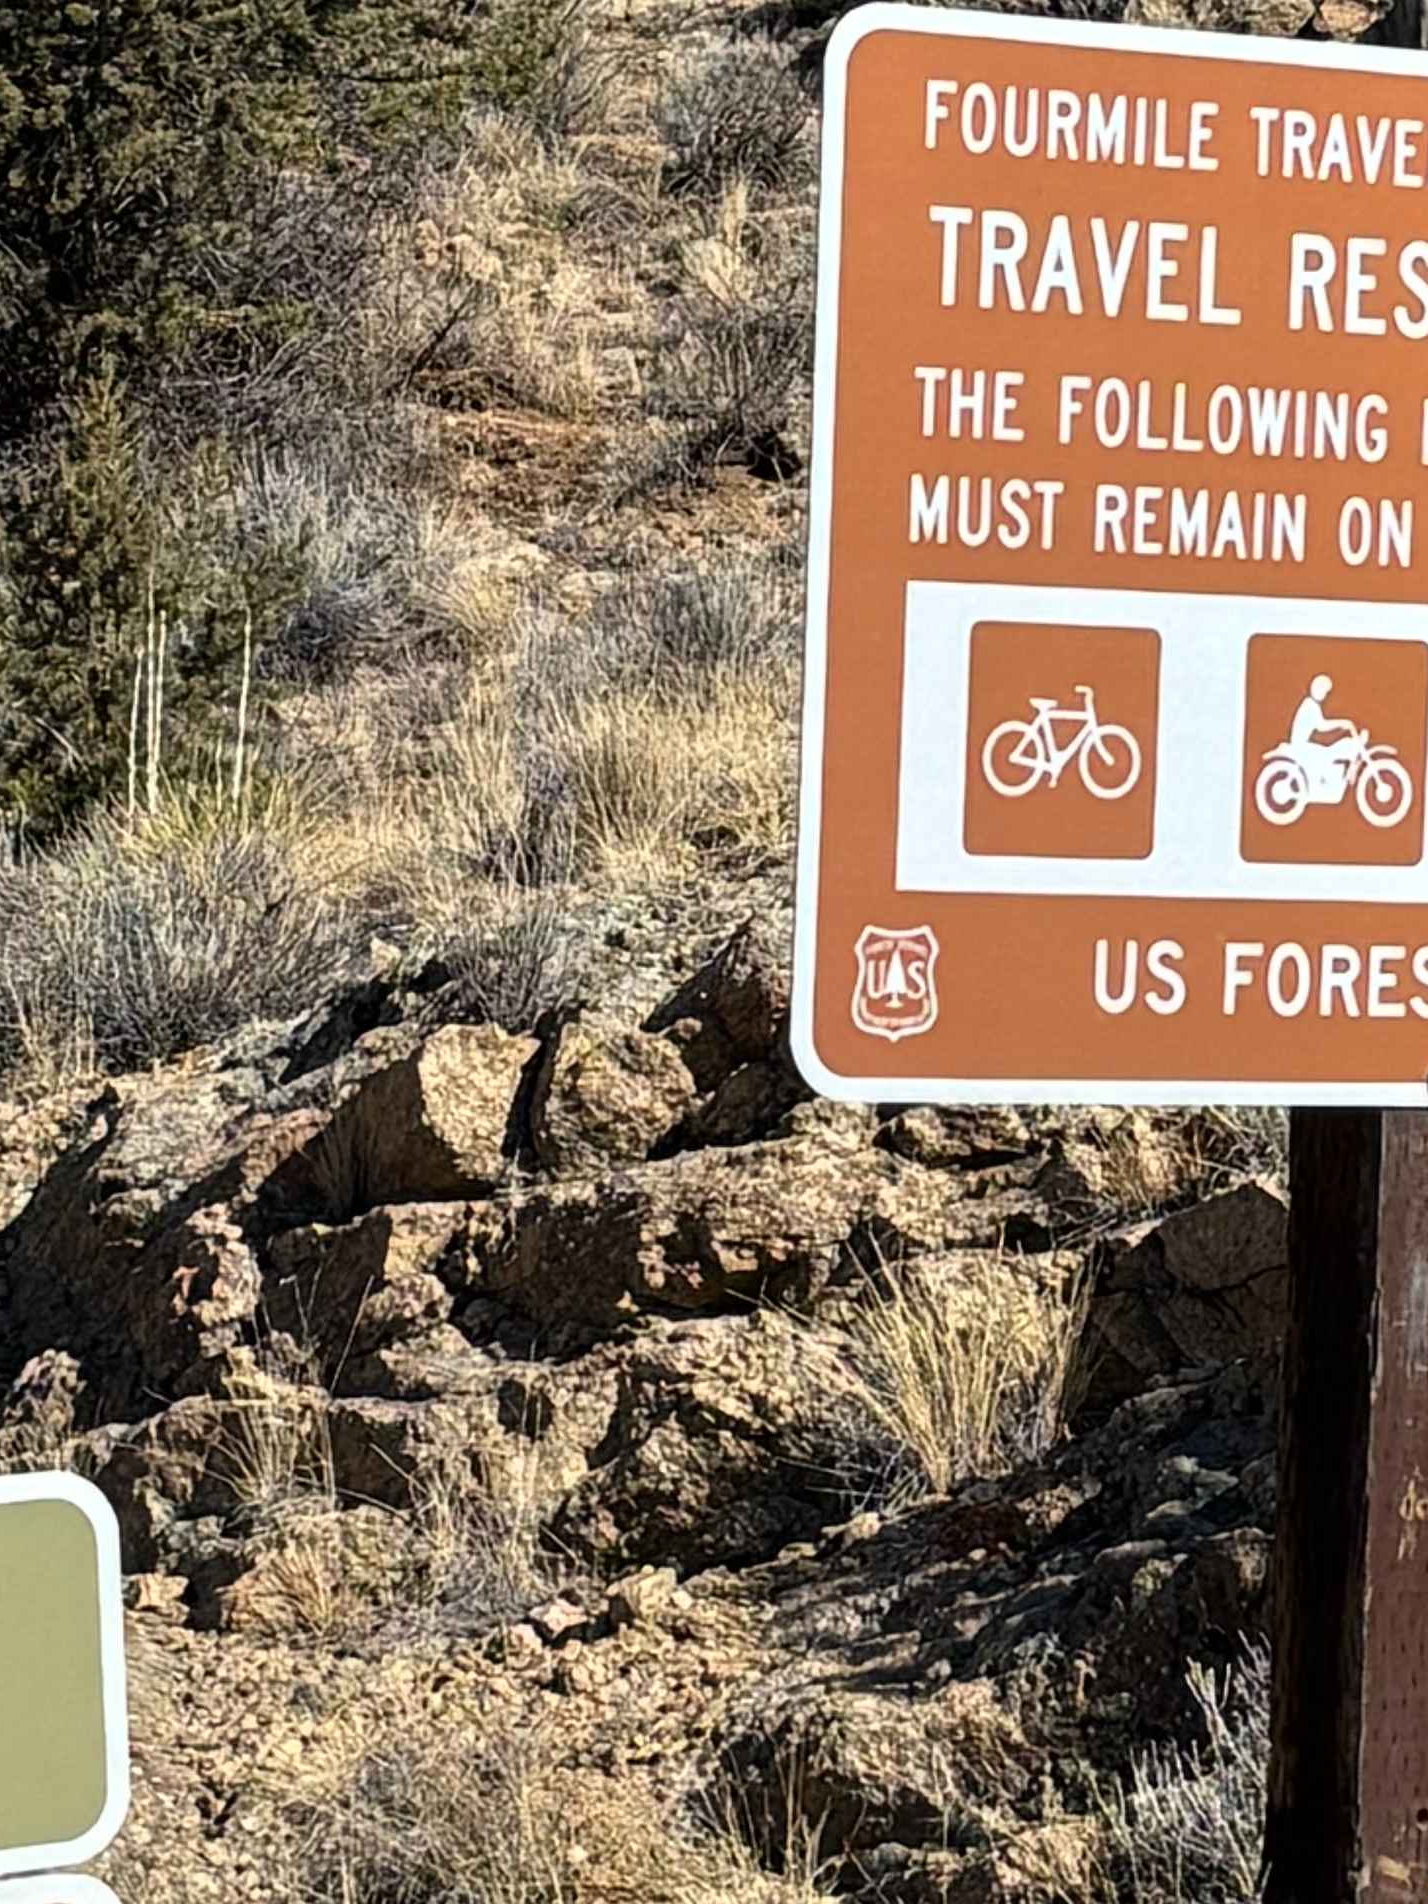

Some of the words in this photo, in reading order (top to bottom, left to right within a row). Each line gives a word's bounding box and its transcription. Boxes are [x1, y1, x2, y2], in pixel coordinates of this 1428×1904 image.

[926, 80, 1218, 170] FOURMILE
[930, 206, 1241, 324] TRAVEL
[915, 367, 1024, 441] THE
[1060, 376, 1388, 463] FOLLOWING
[910, 472, 1064, 549] MUST
[1095, 482, 1306, 561] REMAIN
[1339, 497, 1412, 567] ON
[1095, 940, 1185, 1014] US
